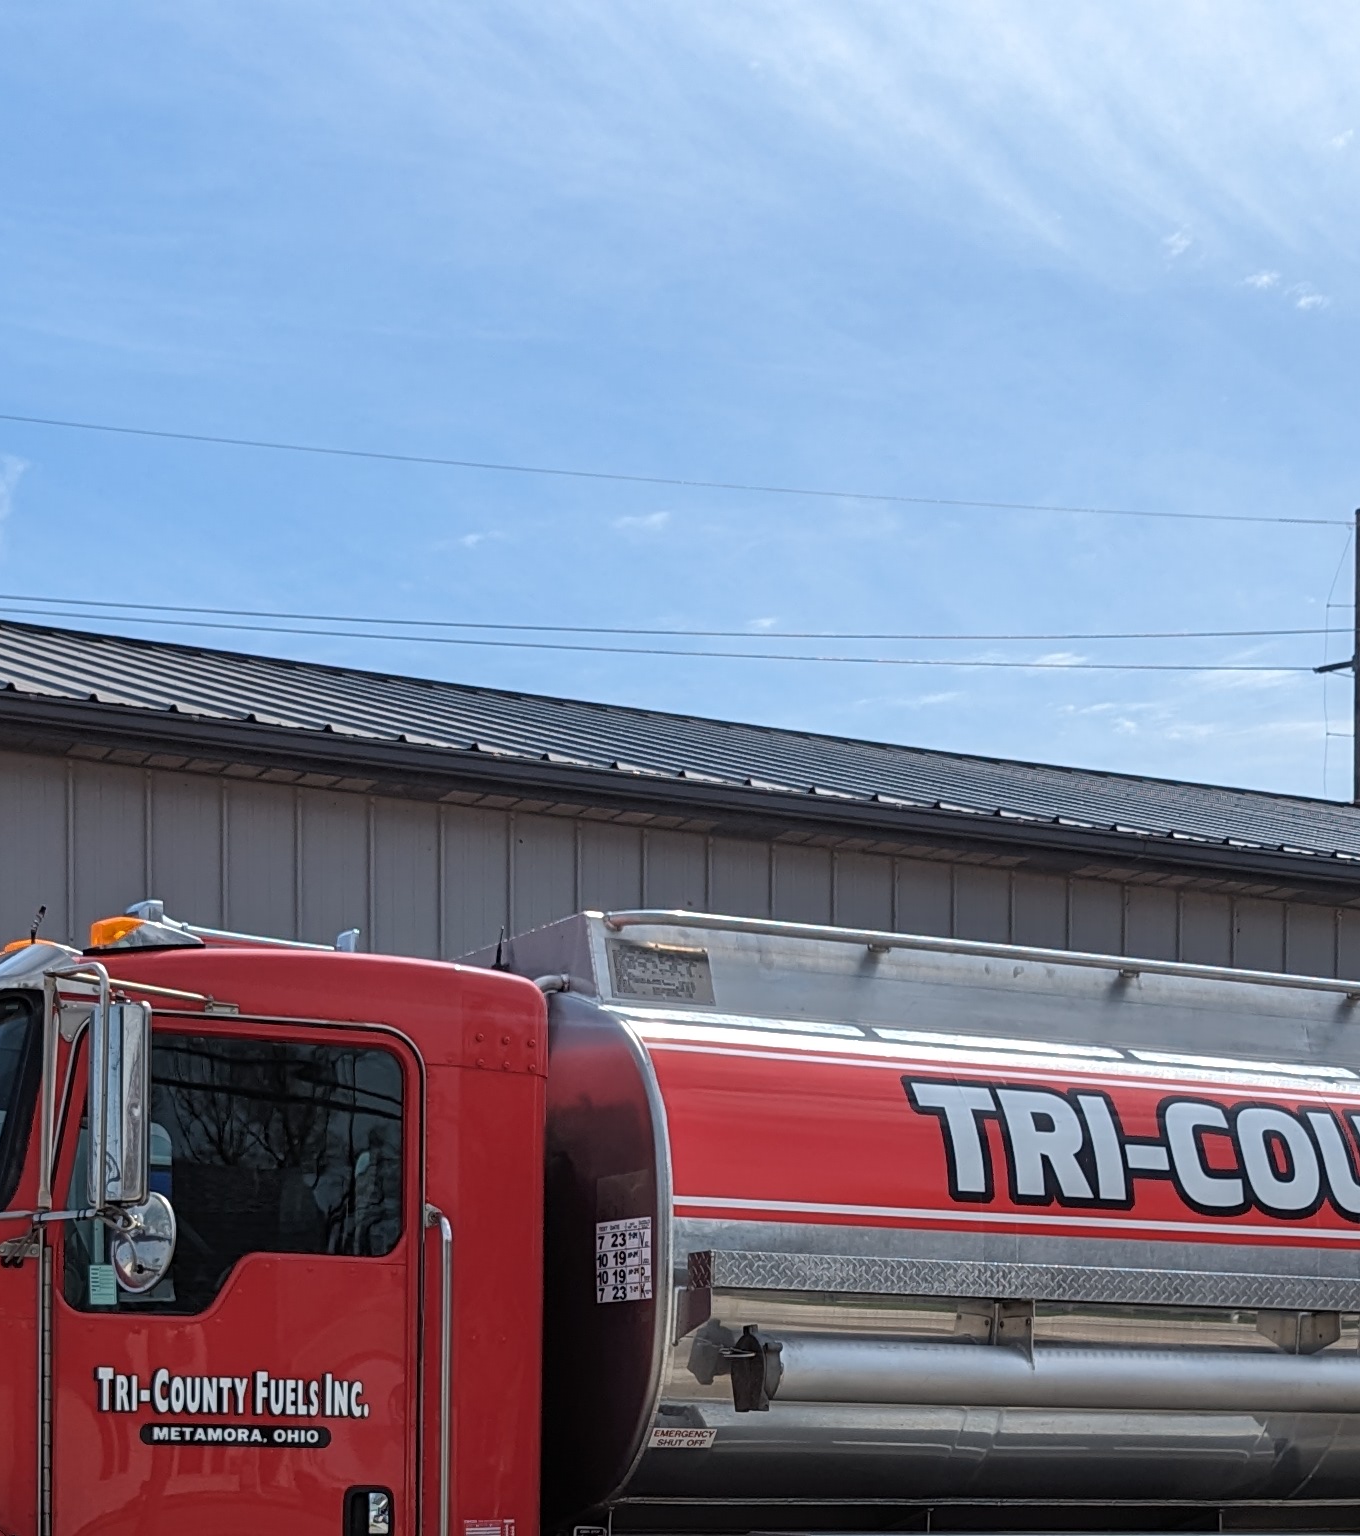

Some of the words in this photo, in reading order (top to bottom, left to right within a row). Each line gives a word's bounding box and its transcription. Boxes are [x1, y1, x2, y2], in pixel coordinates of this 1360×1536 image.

[598, 1236, 605, 1250] 7
[611, 1232, 626, 1247] 23
[597, 1254, 608, 1268] 10
[613, 1251, 626, 1266] 19
[597, 1271, 608, 1286] 10
[612, 1269, 626, 1284] 19
[598, 1288, 605, 1302] 7
[612, 1286, 627, 1300] 23
[253, 1370, 319, 1417] FUELS
[273, 1428, 320, 1444] OHIO
[654, 1430, 715, 1438] EMERGENCY
